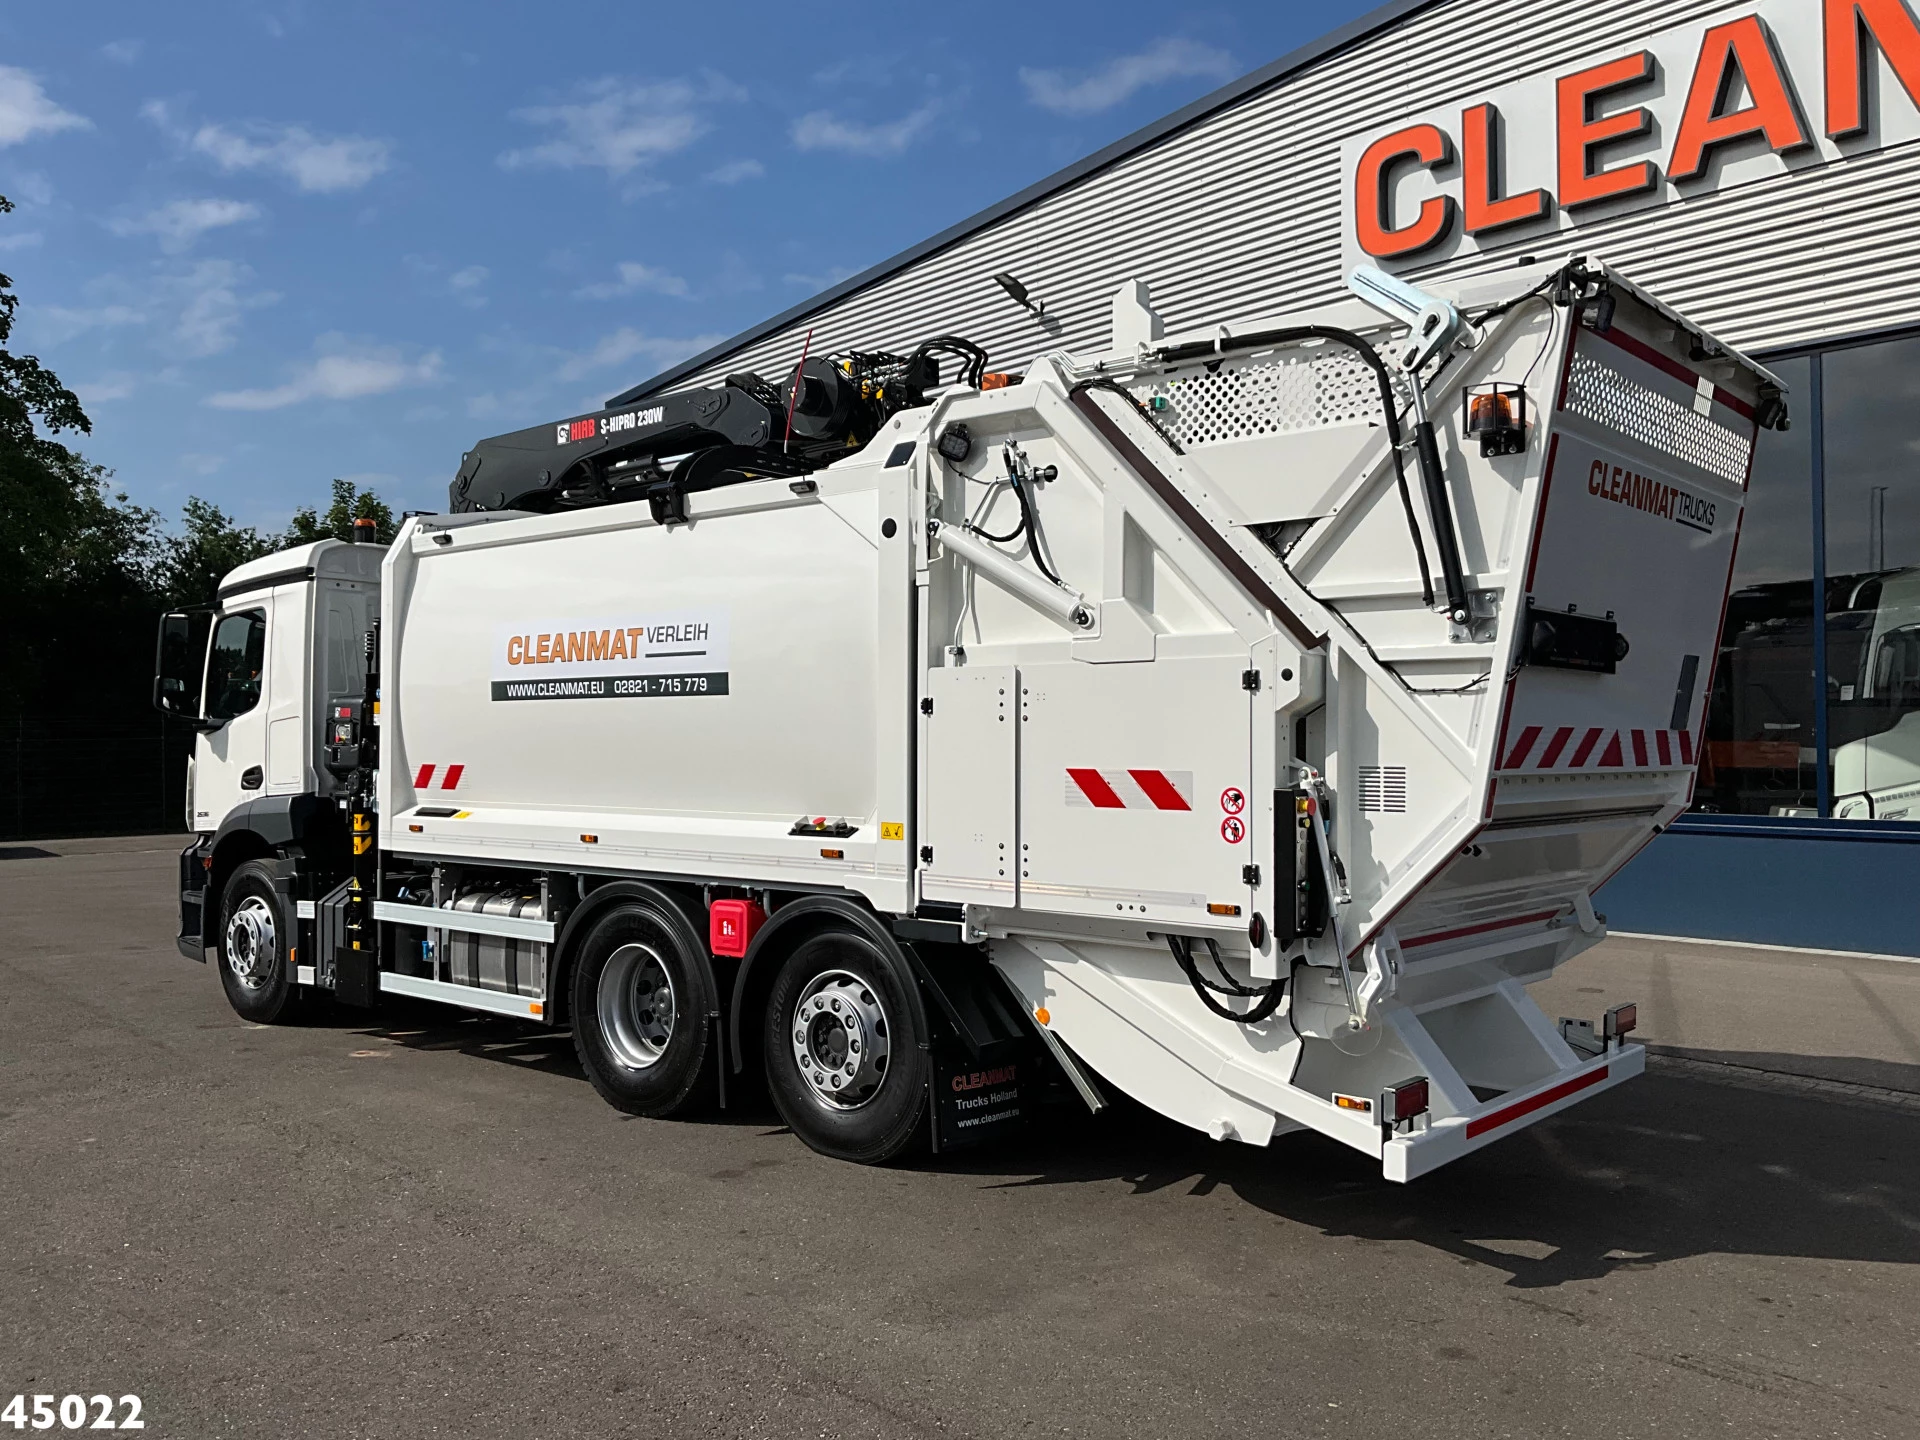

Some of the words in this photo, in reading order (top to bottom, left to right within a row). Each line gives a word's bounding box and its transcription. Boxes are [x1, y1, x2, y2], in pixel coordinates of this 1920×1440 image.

[571, 418, 595, 441] HIAB
[600, 412, 635, 434] S-HIPRO
[637, 406, 663, 427] 230W
[1588, 459, 1678, 520] CLEANMAT
[1678, 491, 1716, 526] TRUCKS
[507, 627, 644, 665] CLEANMAT
[646, 623, 708, 643] VERLEIH
[507, 681, 604, 697] WWW.CLEANMAT.EU
[614, 679, 649, 694] 02821
[659, 678, 681, 693] 715
[684, 677, 707, 692] 779
[952, 1065, 1016, 1092] CLEANMAT
[956, 1096, 989, 1110] Trucks
[990, 1088, 1018, 1104] Holland
